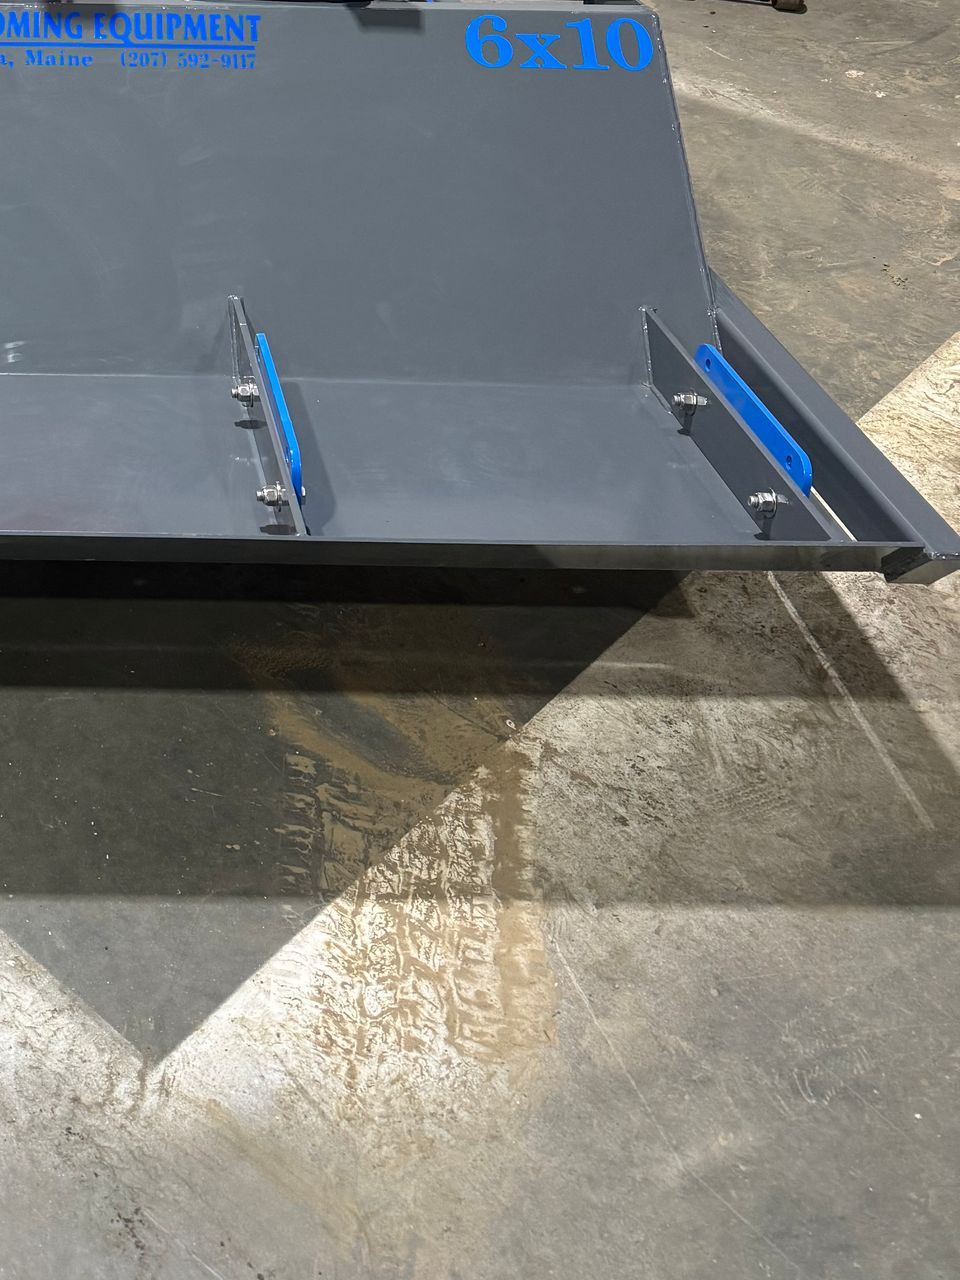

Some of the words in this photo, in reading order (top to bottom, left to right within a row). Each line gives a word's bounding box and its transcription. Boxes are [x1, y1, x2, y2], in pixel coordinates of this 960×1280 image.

[93, 12, 261, 44] EQUIPMENT
[465, 14, 654, 72] 6x10
[25, 49, 93, 67] Maine
[120, 50, 167, 68] (207)
[178, 51, 256, 70] 592-9117
